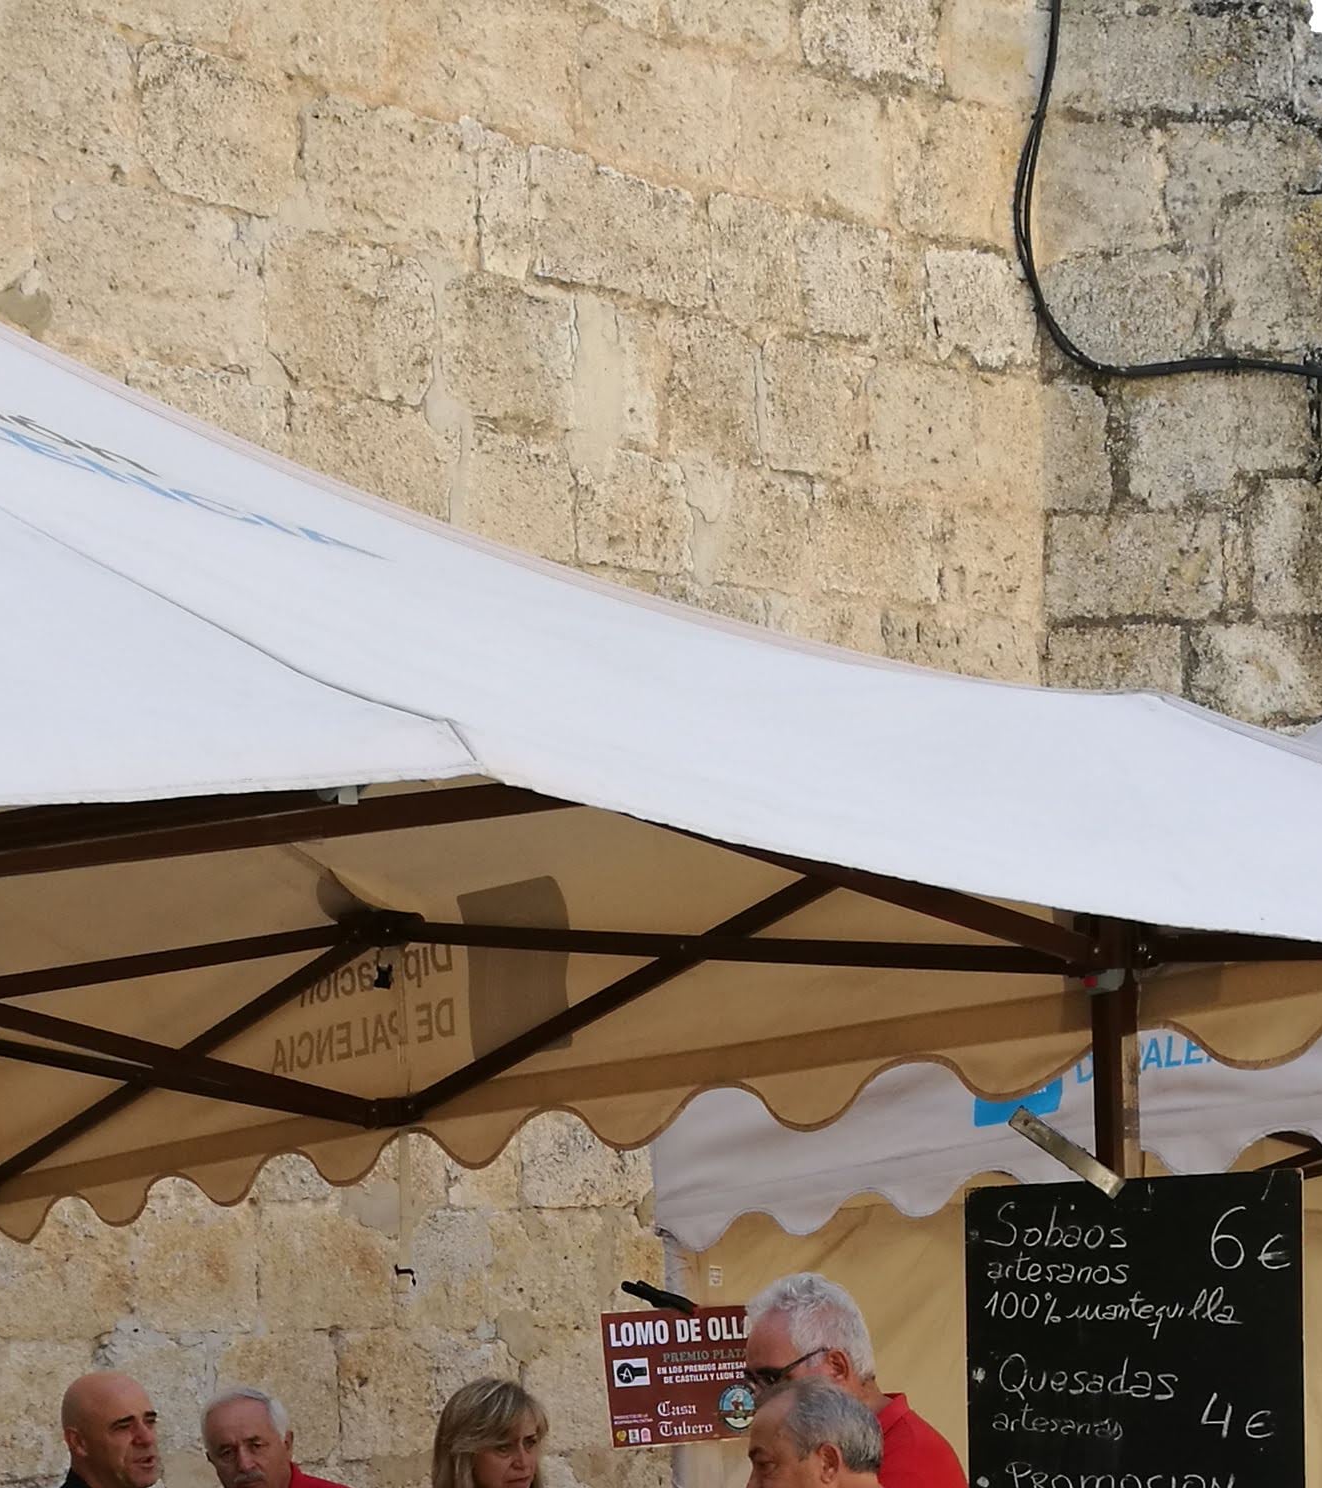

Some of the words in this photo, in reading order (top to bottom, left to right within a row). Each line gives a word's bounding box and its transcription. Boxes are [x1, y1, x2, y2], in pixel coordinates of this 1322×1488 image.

[984, 1200, 1128, 1249] Sobaos
[1210, 1205, 1247, 1270] 6
[1257, 1233, 1292, 1270] €
[986, 1251, 1130, 1285] artesanos
[984, 1290, 1062, 1326] 100%
[1065, 1286, 1245, 1340] mantequilla
[608, 1319, 670, 1348] LOMO
[675, 1318, 702, 1344] DE
[662, 1350, 710, 1363] PREMIO
[998, 1352, 1180, 1401] Quesadas
[656, 1400, 697, 1417] Casa
[1200, 1391, 1233, 1438] 4
[1245, 1409, 1276, 1439] €
[658, 1420, 714, 1437] Tubero
